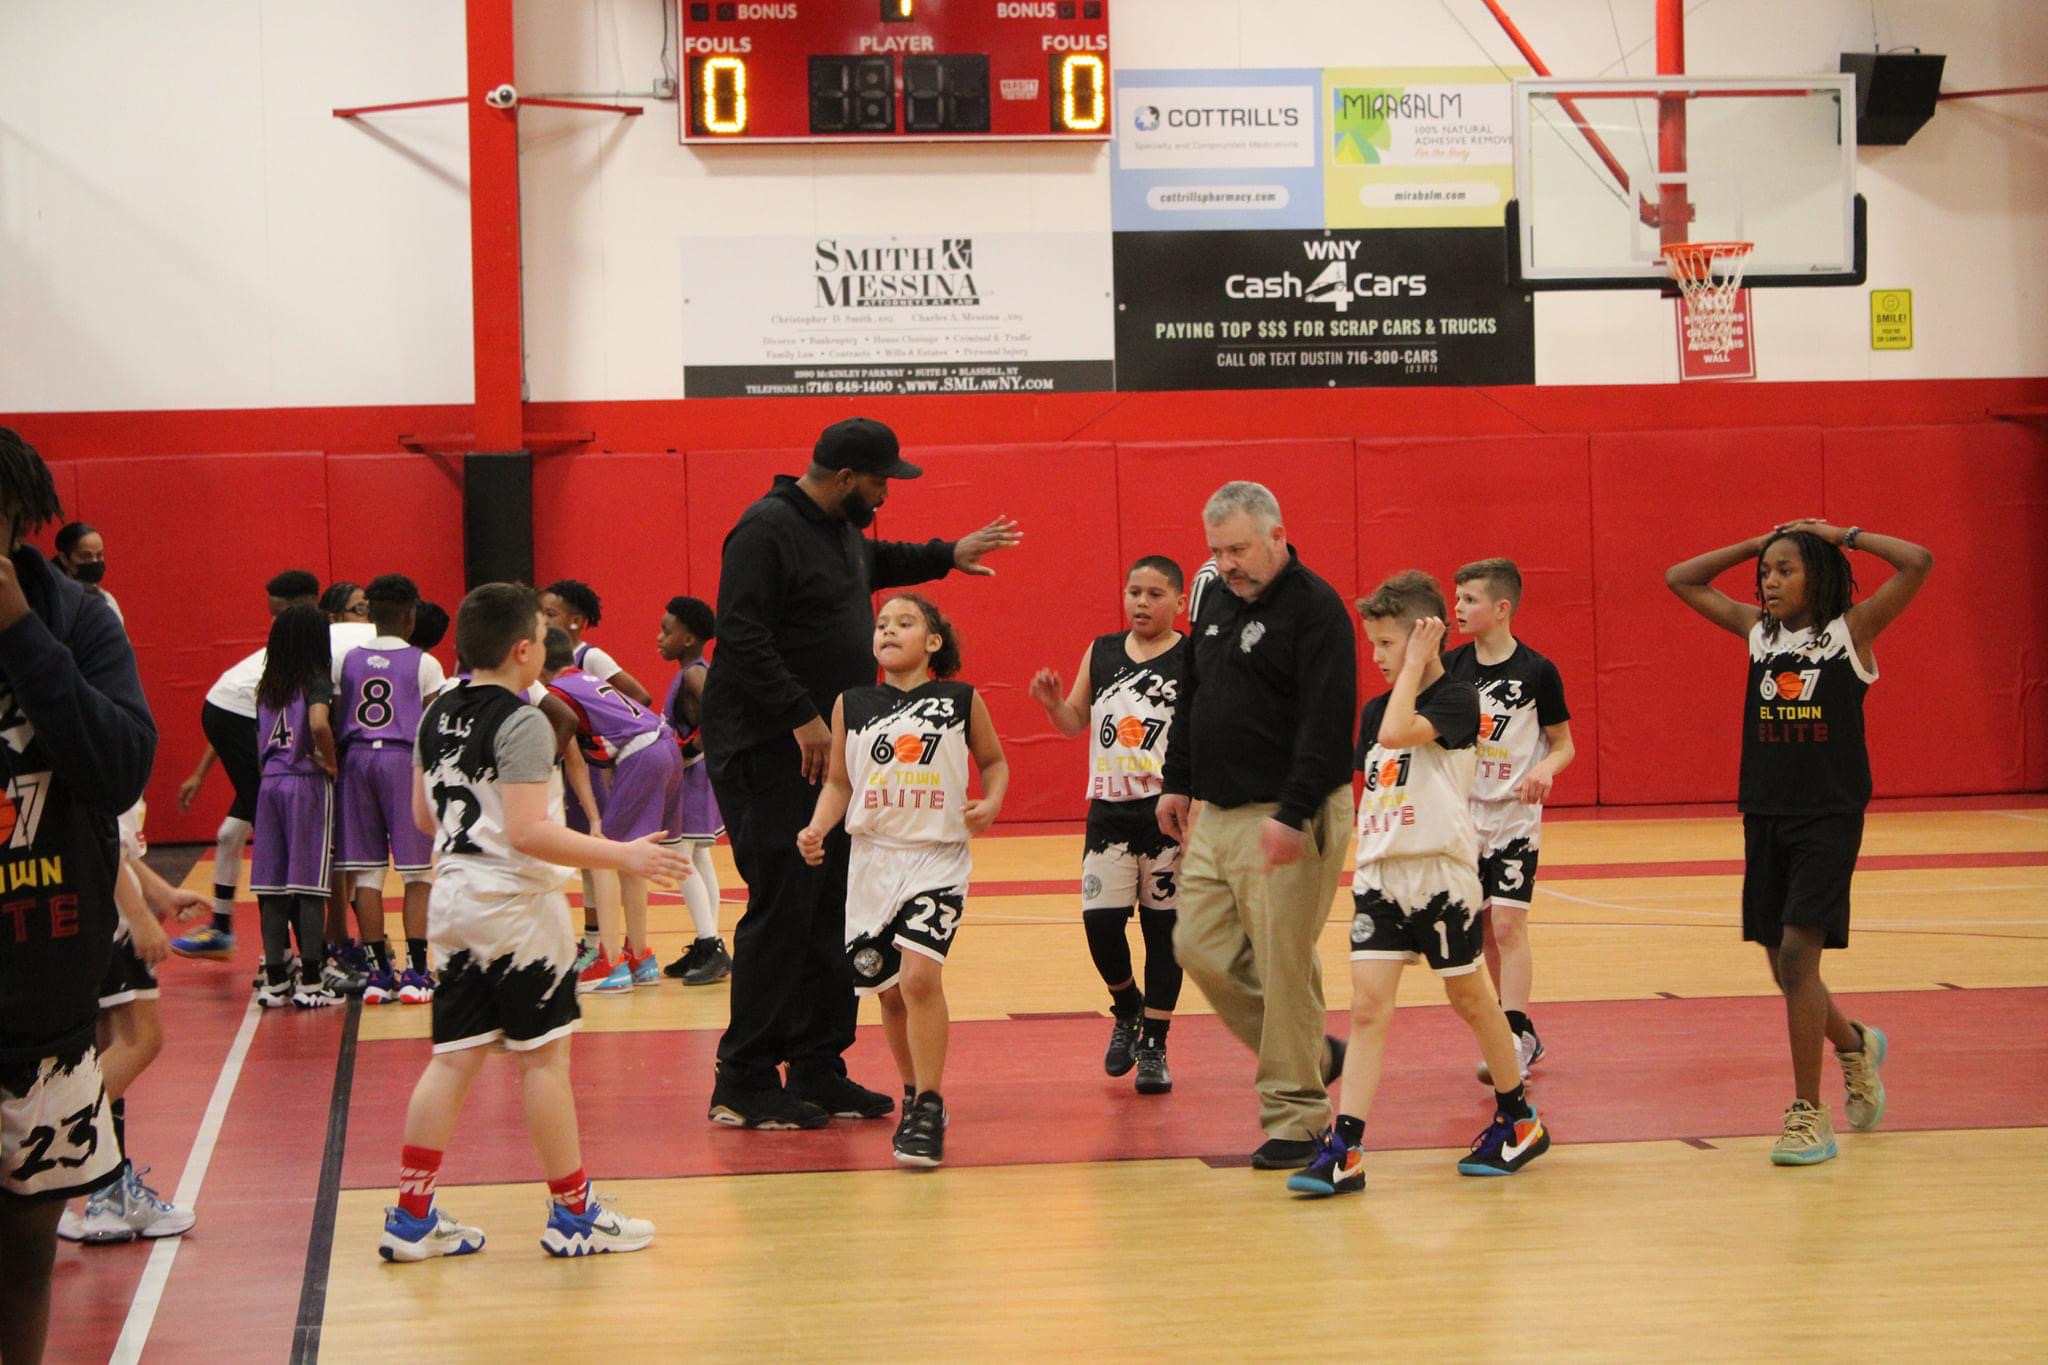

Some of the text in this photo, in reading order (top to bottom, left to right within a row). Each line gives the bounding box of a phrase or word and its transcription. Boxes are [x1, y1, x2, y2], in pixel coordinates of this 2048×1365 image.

[738, 4, 797, 20] BONUS
[996, 2, 1056, 19] BONUS
[685, 36, 752, 53] FOULS
[859, 35, 934, 52] PLAYER
[1041, 34, 1108, 51] FOULS
[703, 56, 747, 133] 0
[1062, 54, 1105, 130] 0
[1342, 92, 1462, 120] MIRABALM
[1167, 107, 1299, 128] COTTRILL'S
[1442, 124, 1493, 134] NATURAL
[1415, 135, 1514, 146] ADHESIVE REMOVE
[1159, 191, 1276, 204] cottrillspharmacy.com
[1394, 190, 1466, 201] mirabalm.com
[942, 239, 972, 271] &
[1303, 240, 1362, 260] WNY
[1225, 261, 1427, 312] Cash 4 Cars
[1155, 317, 1497, 339] PAYING TOP $$$ FOR SCRAP CARS & TRUCKS
[1876, 313, 1907, 324] SMILE!
[1216, 349, 1439, 367] CALL OR TEXT DUSTIN 716-300-CARS
[805, 381, 834, 394] (716)
[834, 380, 893, 393] 648-1400
[1147, 674, 1178, 700] 26
[1504, 679, 1523, 701] 3
[356, 677, 394, 730] 8
[596, 685, 644, 719] 7
[922, 697, 955, 717] 23
[1759, 705, 1823, 720] EL TOWN
[268, 706, 294, 749] 4
[1758, 722, 1829, 743] ELITE
[1096, 755, 1113, 772] EL
[868, 771, 940, 785] EL TOWN
[1094, 772, 1165, 799] ELIT
[864, 788, 945, 810] ELITE
[1498, 858, 1526, 890] 3
[1151, 871, 1177, 902] 3
[904, 895, 960, 942] 23
[1432, 920, 1450, 960] 1
[11, 1103, 98, 1182] 23
